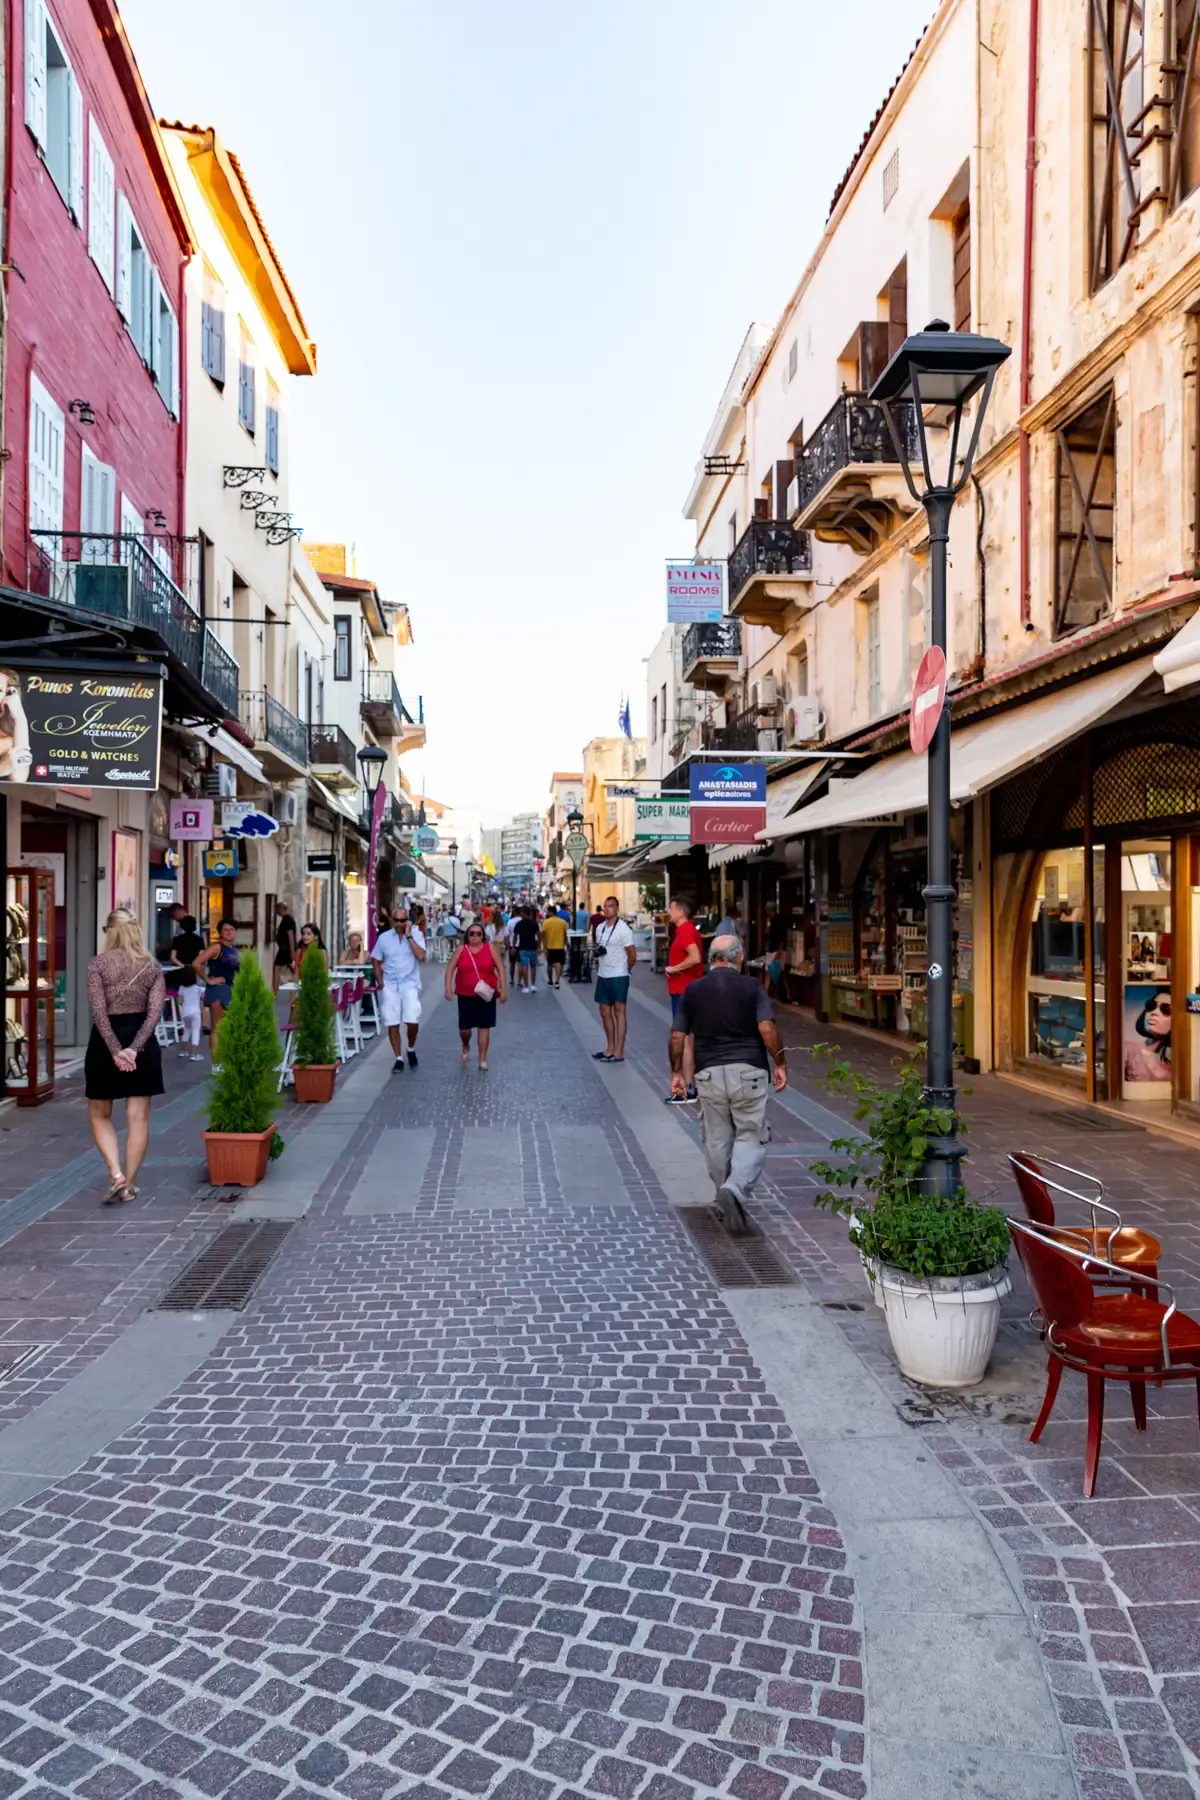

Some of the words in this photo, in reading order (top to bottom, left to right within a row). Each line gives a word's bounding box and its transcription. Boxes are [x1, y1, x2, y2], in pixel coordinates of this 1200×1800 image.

[669, 586, 720, 595] ROOMS
[26, 675, 74, 695] Panos
[79, 679, 155, 700] Koromilas
[30, 700, 152, 750] Jewellery
[82, 729, 138, 739] ΚΟΣΜΗΜΑΤΑ
[48, 749, 79, 759] GOLD
[80, 749, 89, 760] &
[91, 751, 140, 762] WATCHES
[65, 765, 89, 773] MILITARY
[104, 768, 152, 781] Ingersoll
[698, 781, 757, 789] ANASTASIADIS
[703, 789, 752, 799] opticastores
[636, 804, 664, 820] SUPER
[703, 816, 753, 833] Cartier
[158, 891, 173, 900] ATM
